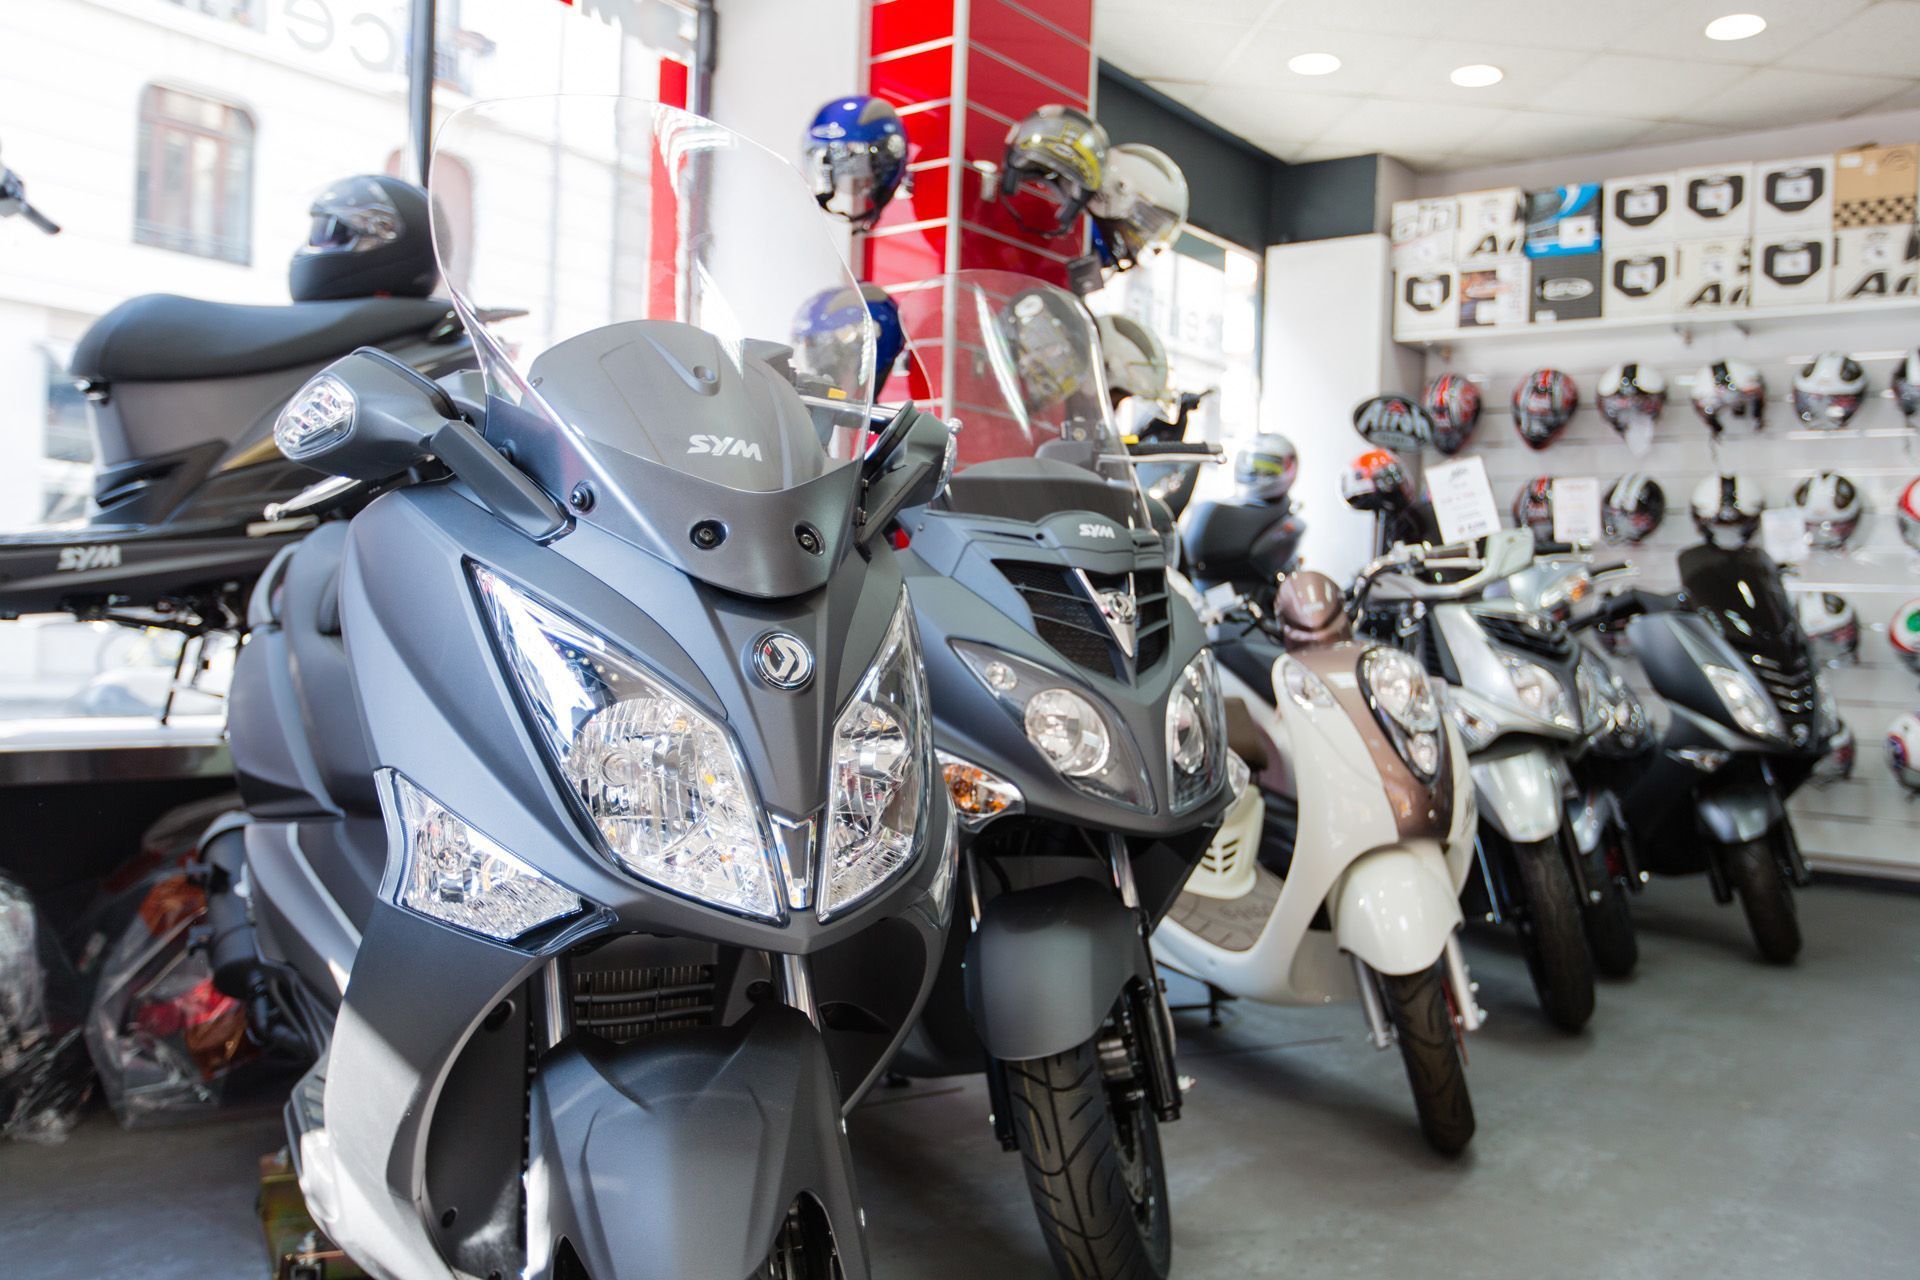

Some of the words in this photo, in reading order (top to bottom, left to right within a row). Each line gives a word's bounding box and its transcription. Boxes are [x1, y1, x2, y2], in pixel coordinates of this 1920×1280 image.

[687, 434, 763, 462] SYM
[1079, 523, 1116, 539] SYM
[57, 544, 122, 571] SYM
